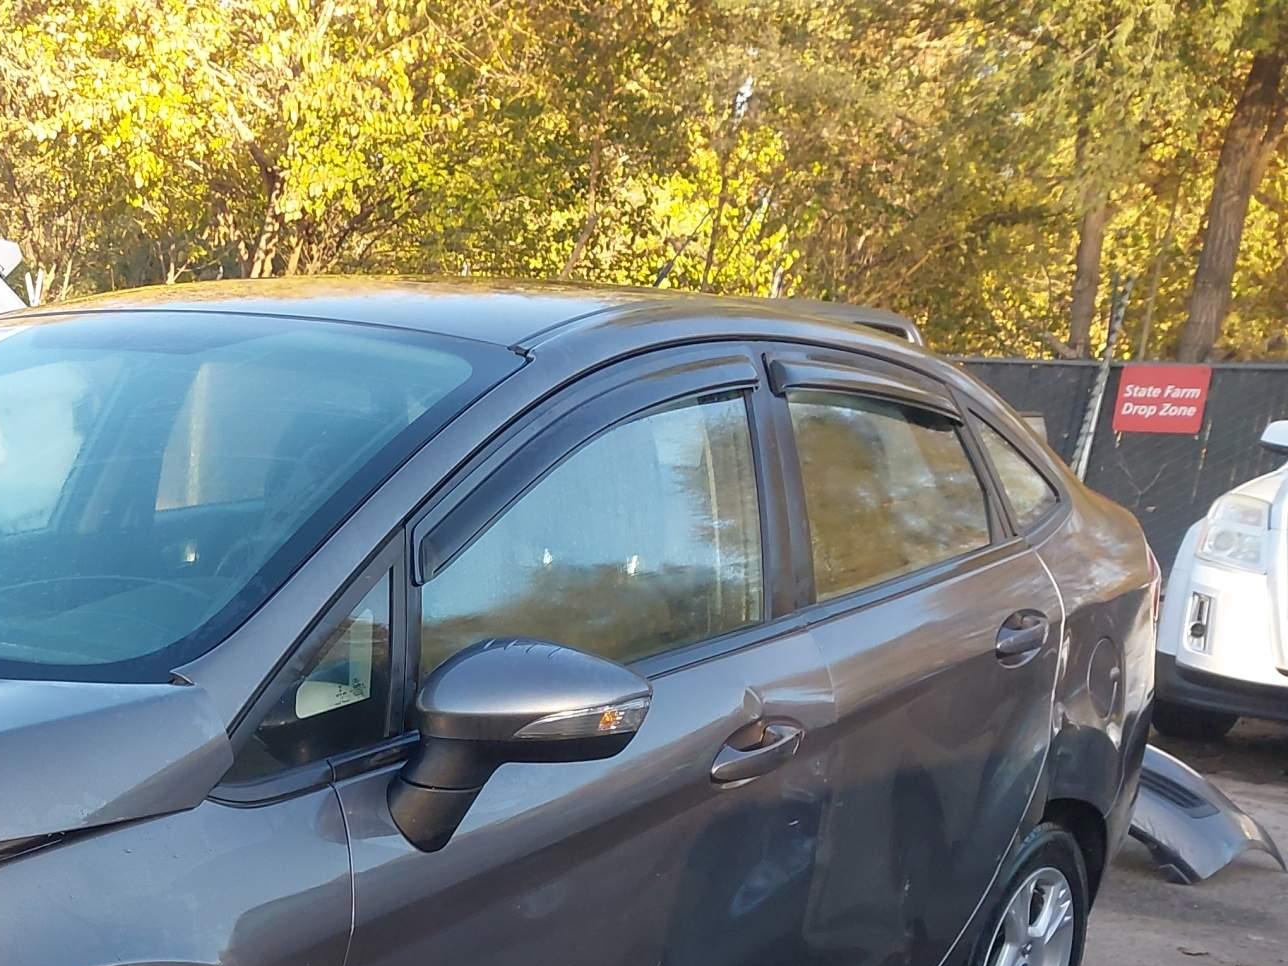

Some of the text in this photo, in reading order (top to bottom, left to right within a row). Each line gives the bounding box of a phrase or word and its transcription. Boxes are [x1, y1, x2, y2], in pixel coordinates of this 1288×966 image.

[1123, 384, 1201, 399] State Farm
[1121, 402, 1198, 418] Drop Zone
